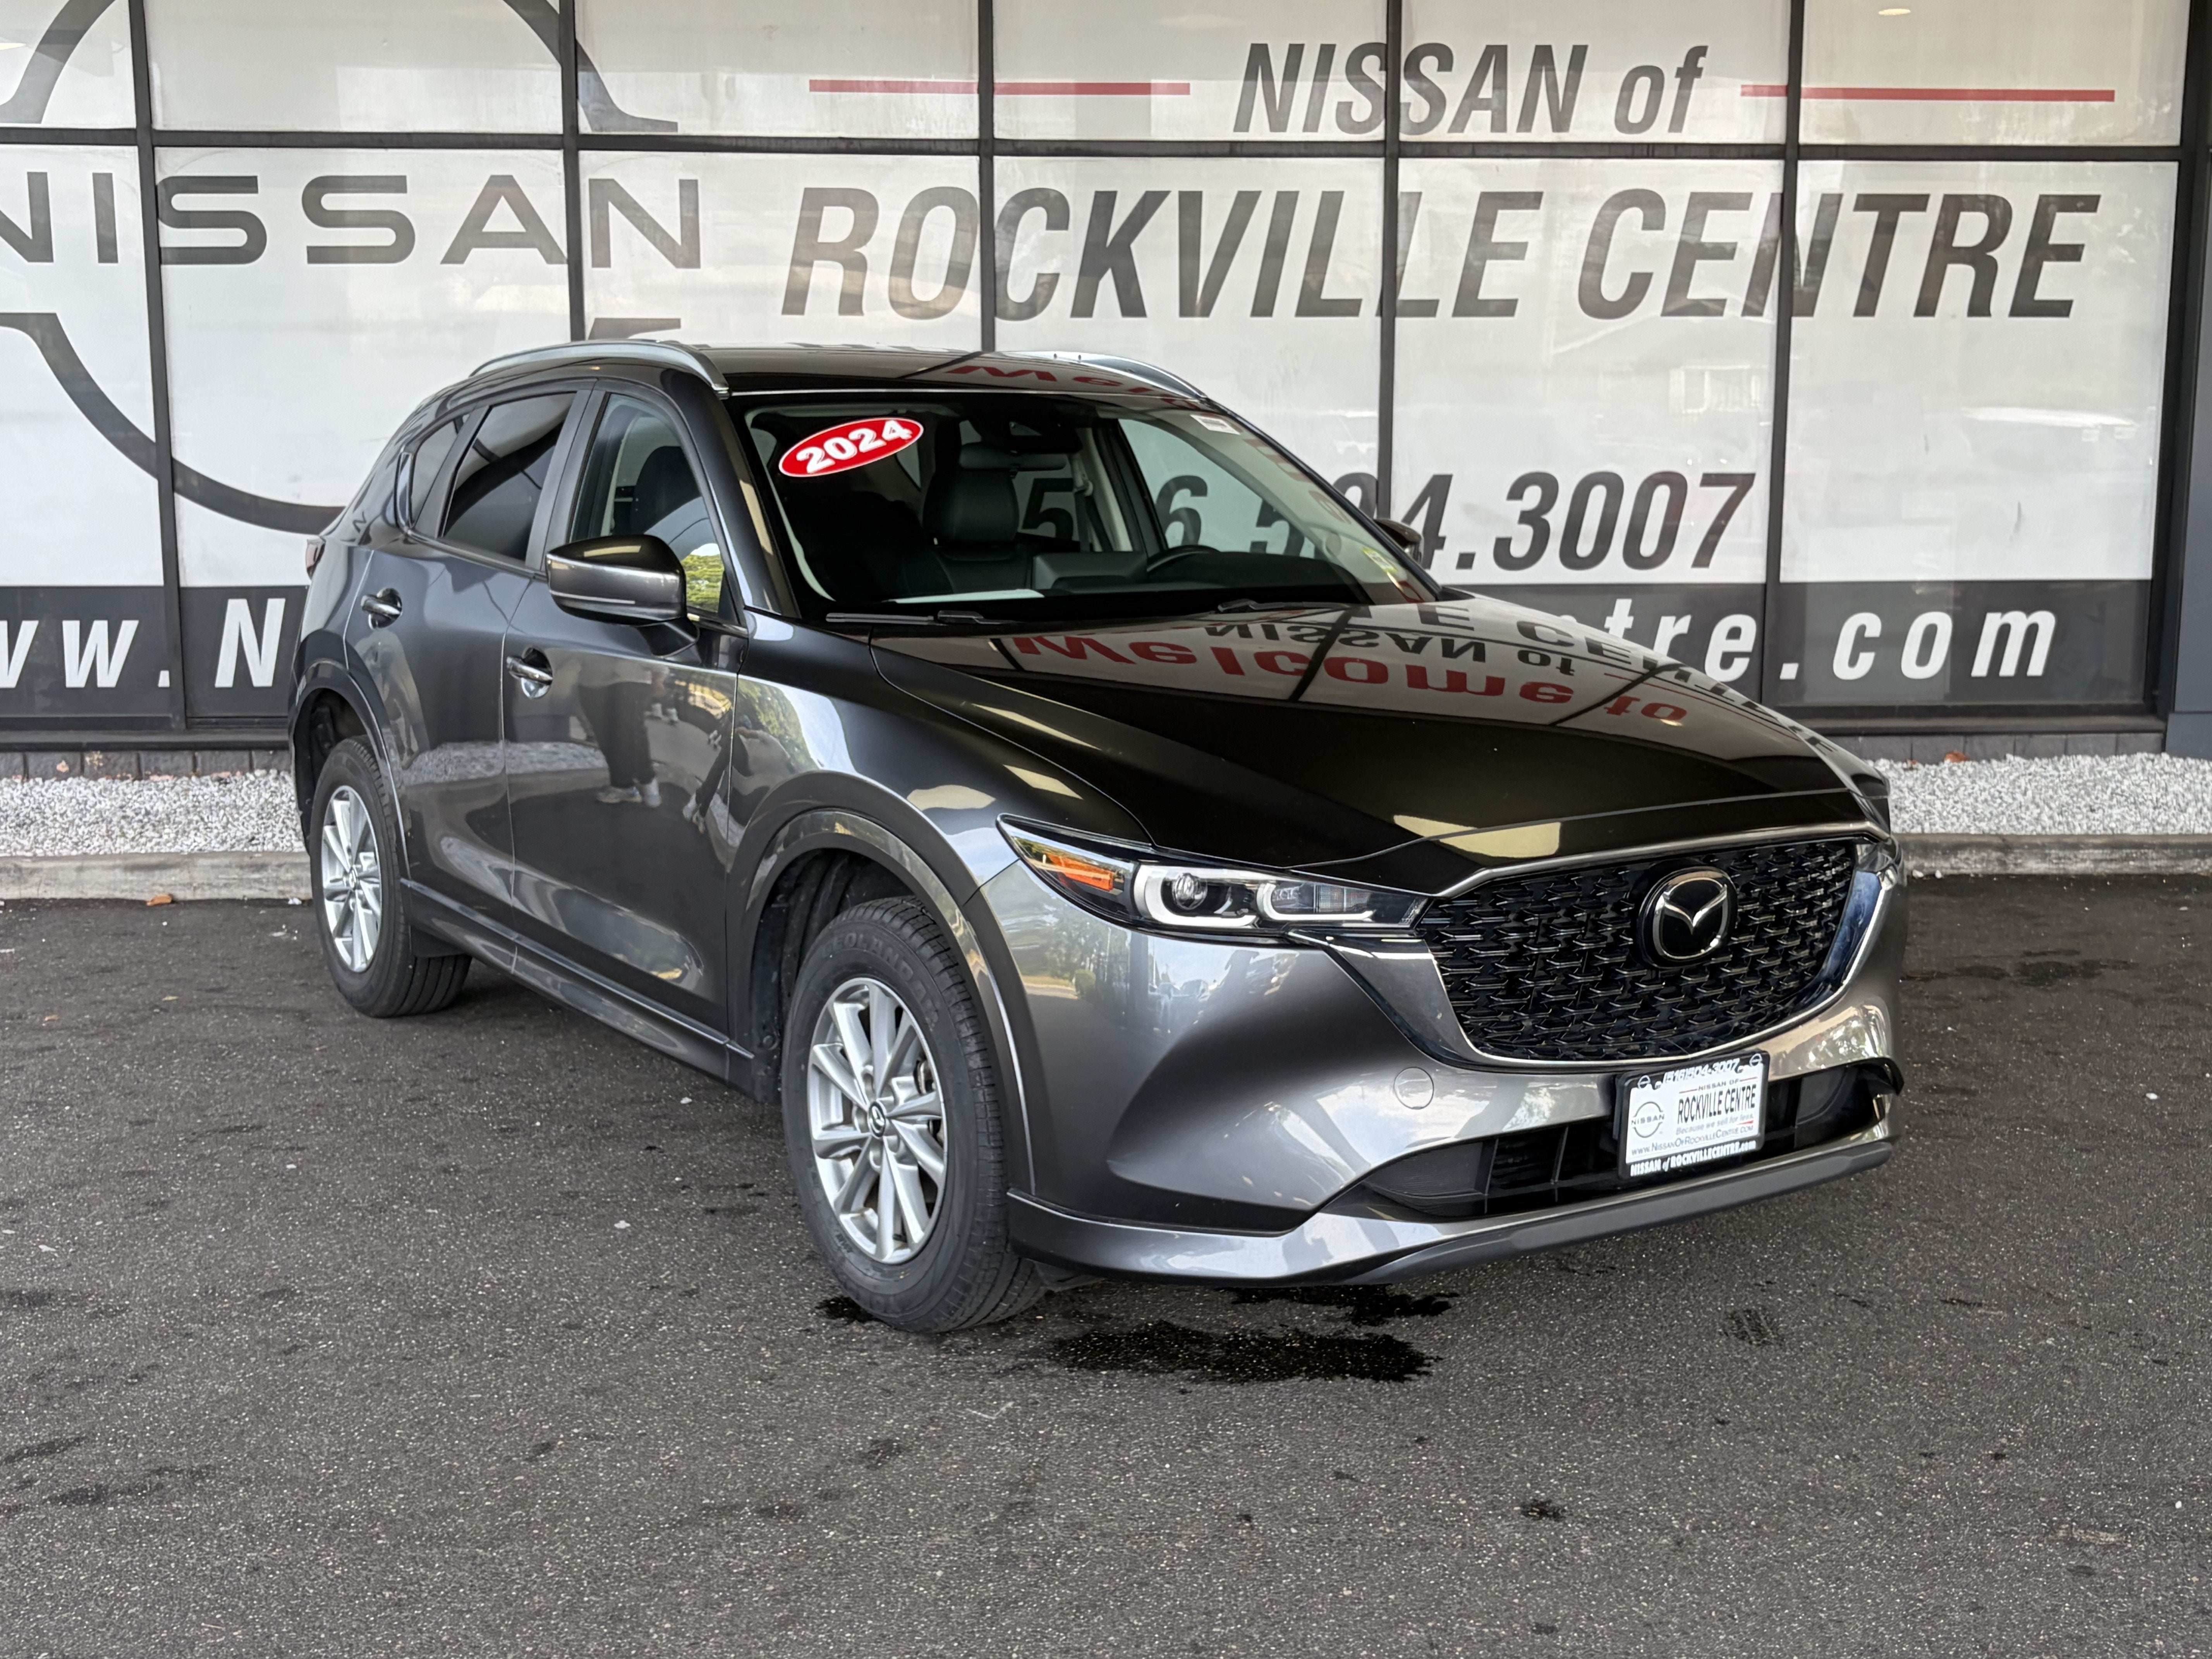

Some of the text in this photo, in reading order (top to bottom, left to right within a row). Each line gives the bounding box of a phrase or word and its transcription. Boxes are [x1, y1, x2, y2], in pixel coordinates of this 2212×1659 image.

[1233, 42, 1708, 135] NISSAN of
[781, 186, 2101, 322] ROCKVILLE CENTRE
[796, 420, 912, 474] 2024
[1677, 1084, 1757, 1124] ROCKVILLE CENTRE
[1698, 1081, 1726, 1091] NISSAN
[1631, 1114, 1665, 1125] NISSAN
[1630, 1158, 1661, 1176] NISSAN
